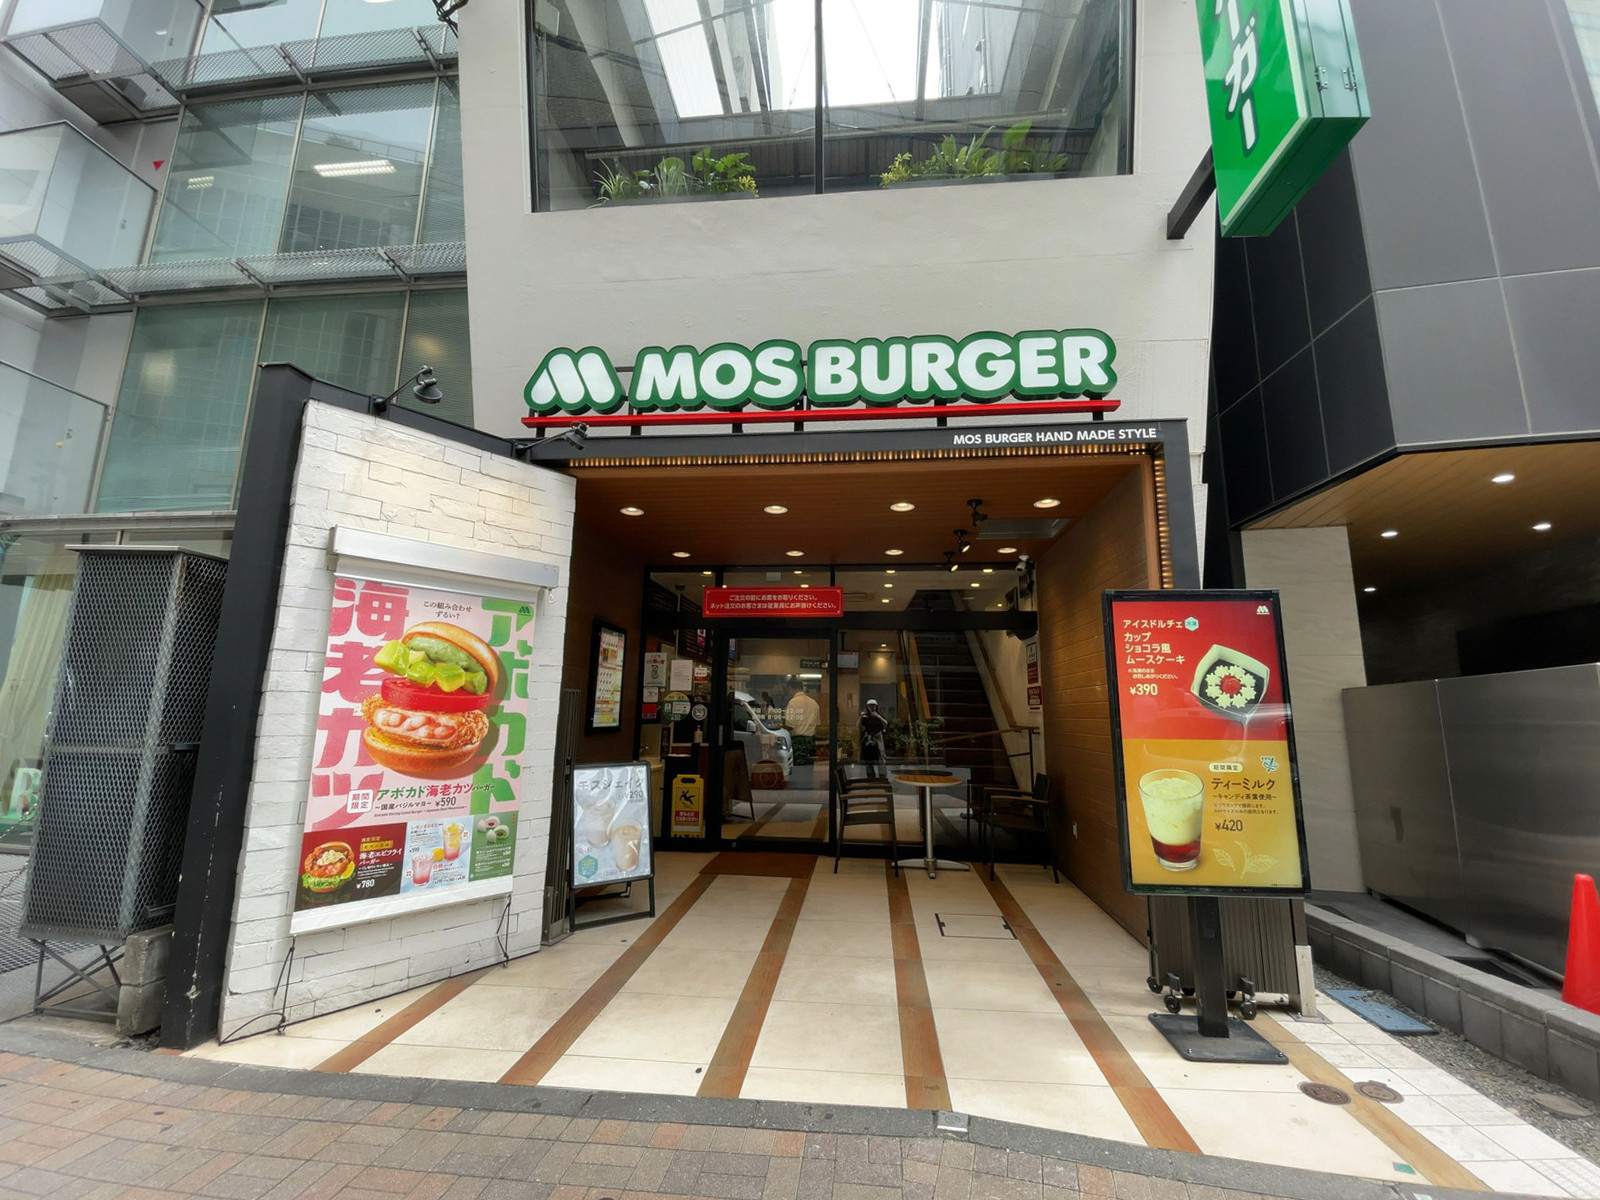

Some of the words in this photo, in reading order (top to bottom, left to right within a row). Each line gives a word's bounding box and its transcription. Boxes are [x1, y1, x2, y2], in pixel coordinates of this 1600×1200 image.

[1214, 0, 1256, 150] ーガー
[635, 346, 799, 401] MOS
[813, 338, 1109, 397] BURGER
[953, 434, 982, 445] MOS
[985, 432, 1033, 444] BURGER
[1036, 431, 1073, 442] HAND
[1076, 429, 1115, 441] MADE
[1118, 428, 1157, 439] STYLE
[423, 601, 473, 612] この組み合わせ
[1123, 619, 1183, 629] アイスドルチェ
[1124, 631, 1151, 642] カップ
[1125, 643, 1171, 654] ショコラ風
[1126, 654, 1185, 665] ムースケーキ
[1129, 683, 1158, 696] ¥390
[1211, 777, 1276, 790] ティーミルク
[376, 783, 495, 801] アボカド海老カツバーガー
[435, 796, 456, 807] ¥590
[1214, 819, 1243, 832] ¥420
[356, 878, 375, 889] ¥780
